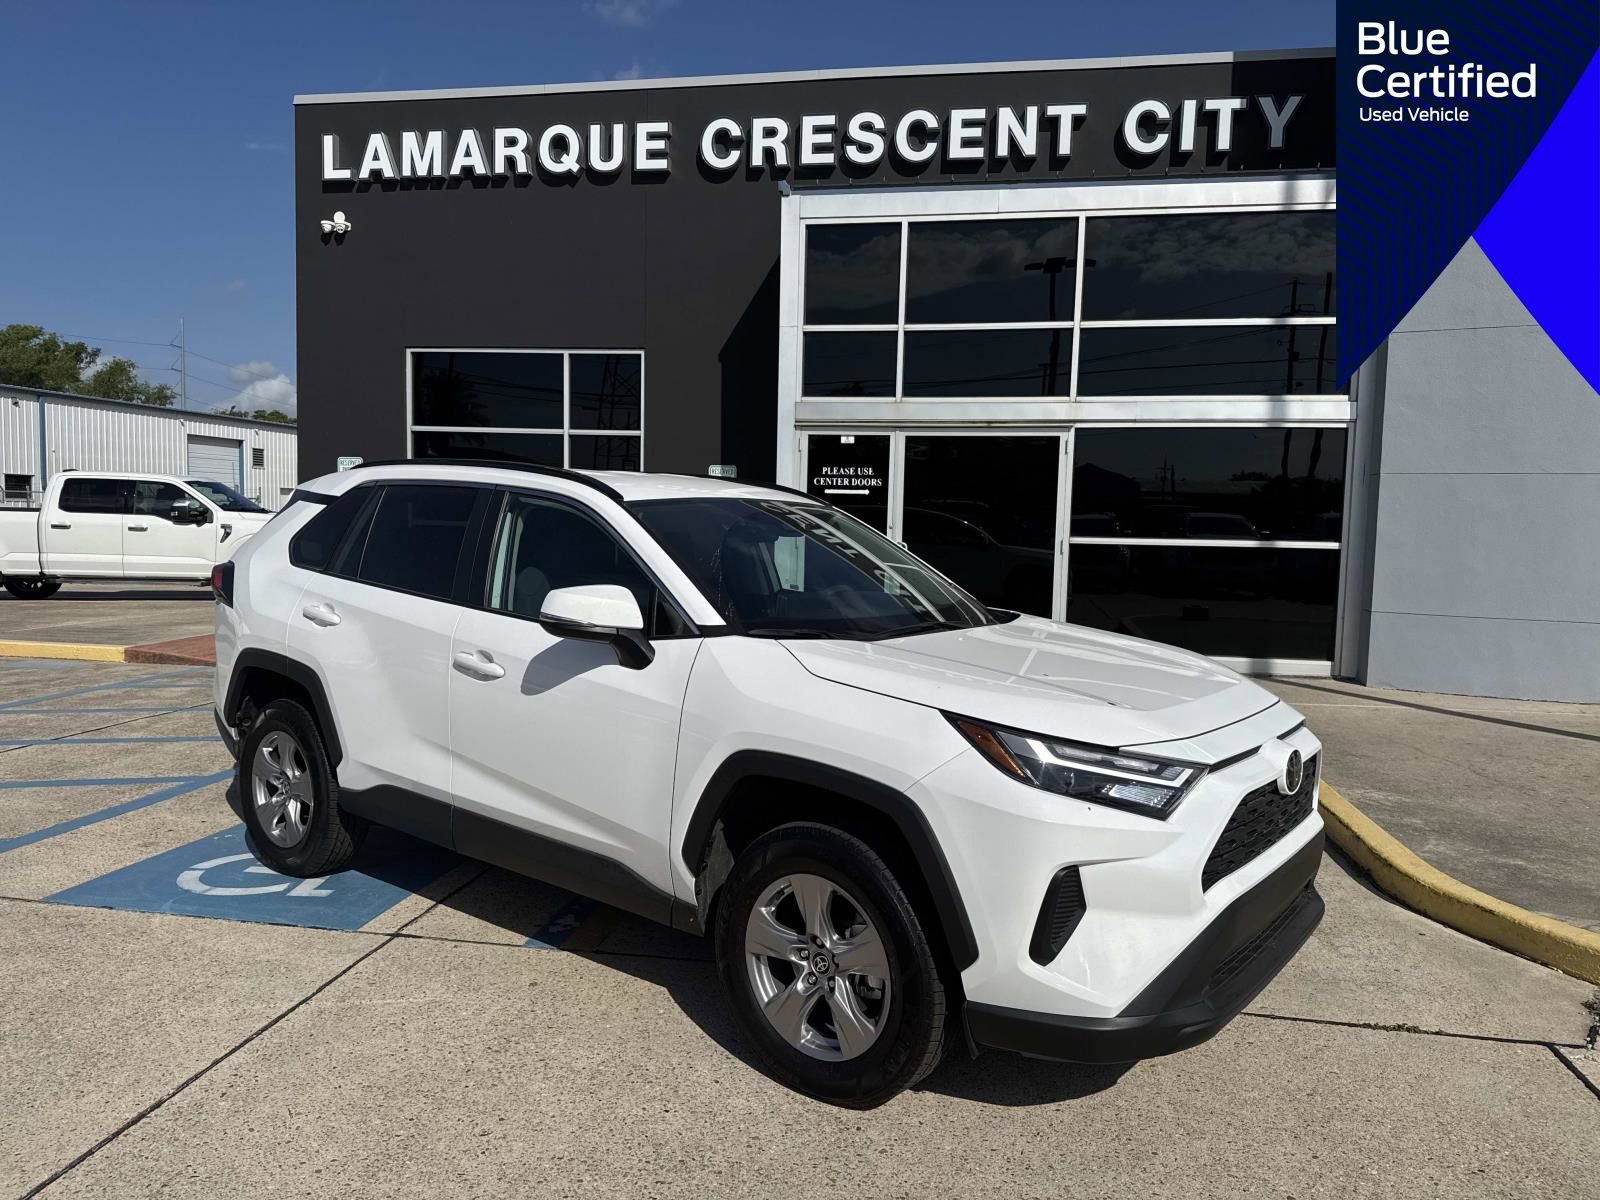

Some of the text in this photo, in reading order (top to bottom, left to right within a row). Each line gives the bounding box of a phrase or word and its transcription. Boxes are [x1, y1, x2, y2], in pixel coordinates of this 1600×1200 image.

[321, 95, 1303, 181] LAMARQUE CRESCENT CITY
[822, 466, 875, 476] PLEASE USE
[813, 477, 883, 487] CENTER DOORS
